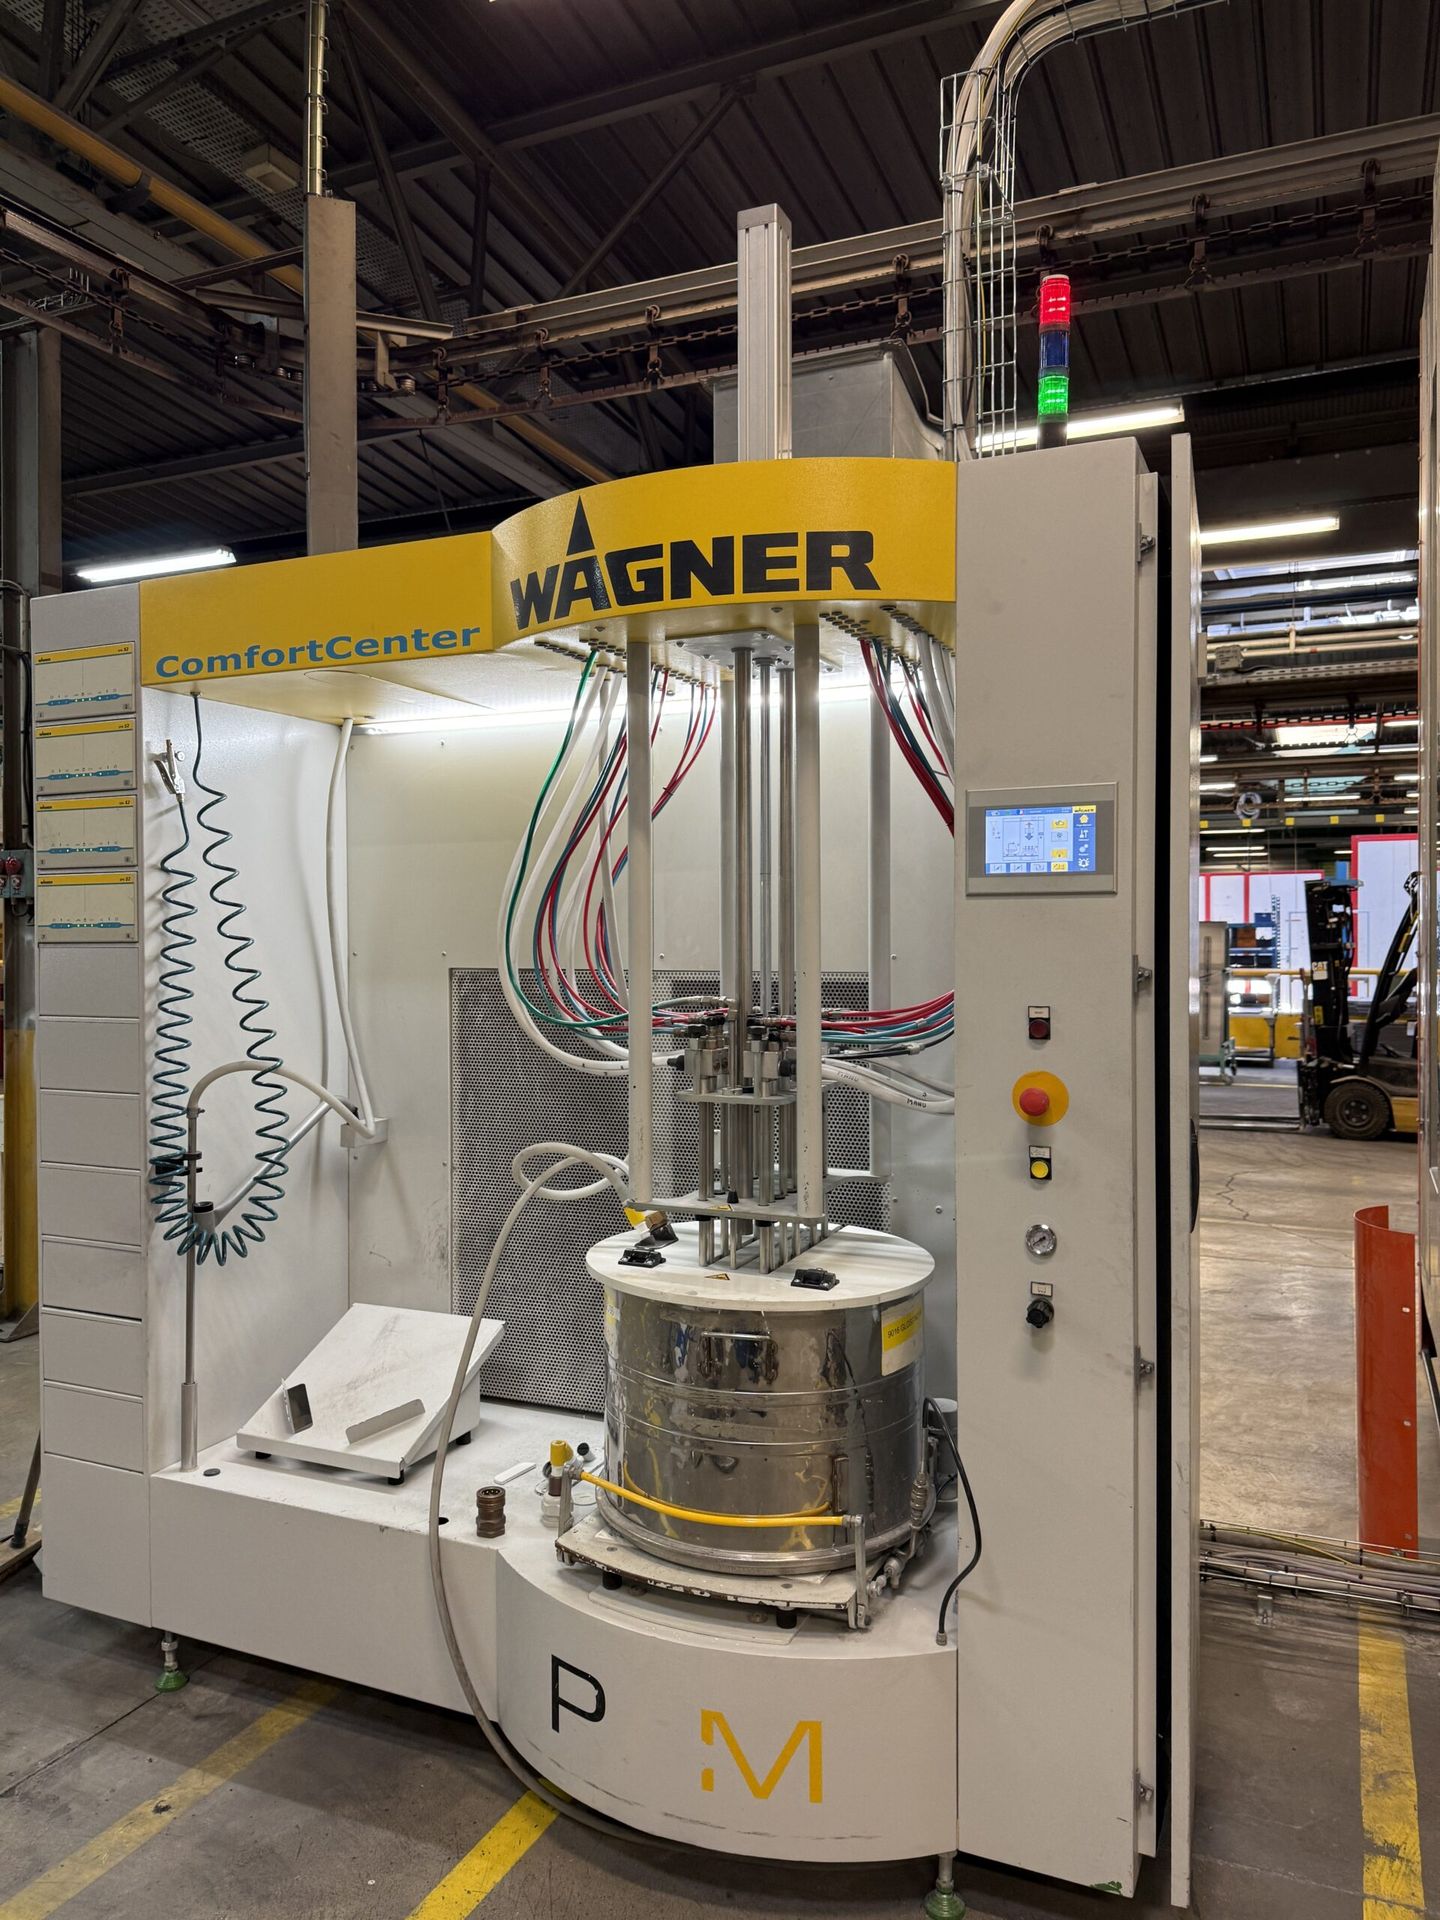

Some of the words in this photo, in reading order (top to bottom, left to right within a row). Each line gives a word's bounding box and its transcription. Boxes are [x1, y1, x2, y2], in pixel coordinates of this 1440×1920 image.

[511, 496, 881, 630] WAGNER
[156, 627, 480, 678] ComfortCenter
[1312, 961, 1328, 971] CAT
[551, 1654, 606, 1733] P
[701, 1708, 822, 1804] M
